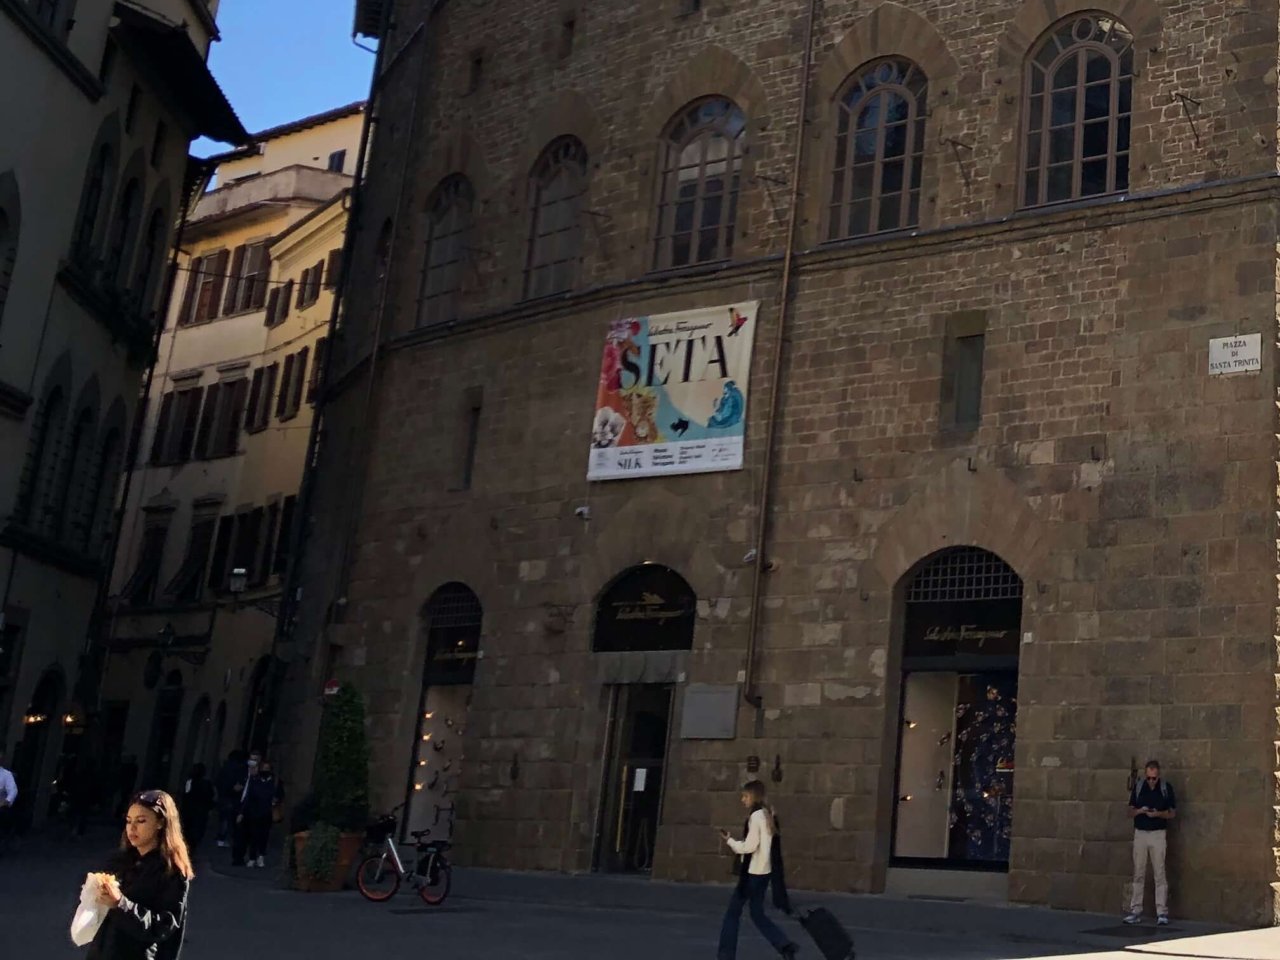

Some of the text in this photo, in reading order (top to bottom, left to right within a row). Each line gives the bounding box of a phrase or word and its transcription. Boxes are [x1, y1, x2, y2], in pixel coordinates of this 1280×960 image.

[1222, 341, 1247, 349] PIAZZA
[617, 335, 729, 390] SETA
[1210, 358, 1259, 369] SANTA TRINITA
[616, 457, 643, 470] SILK
